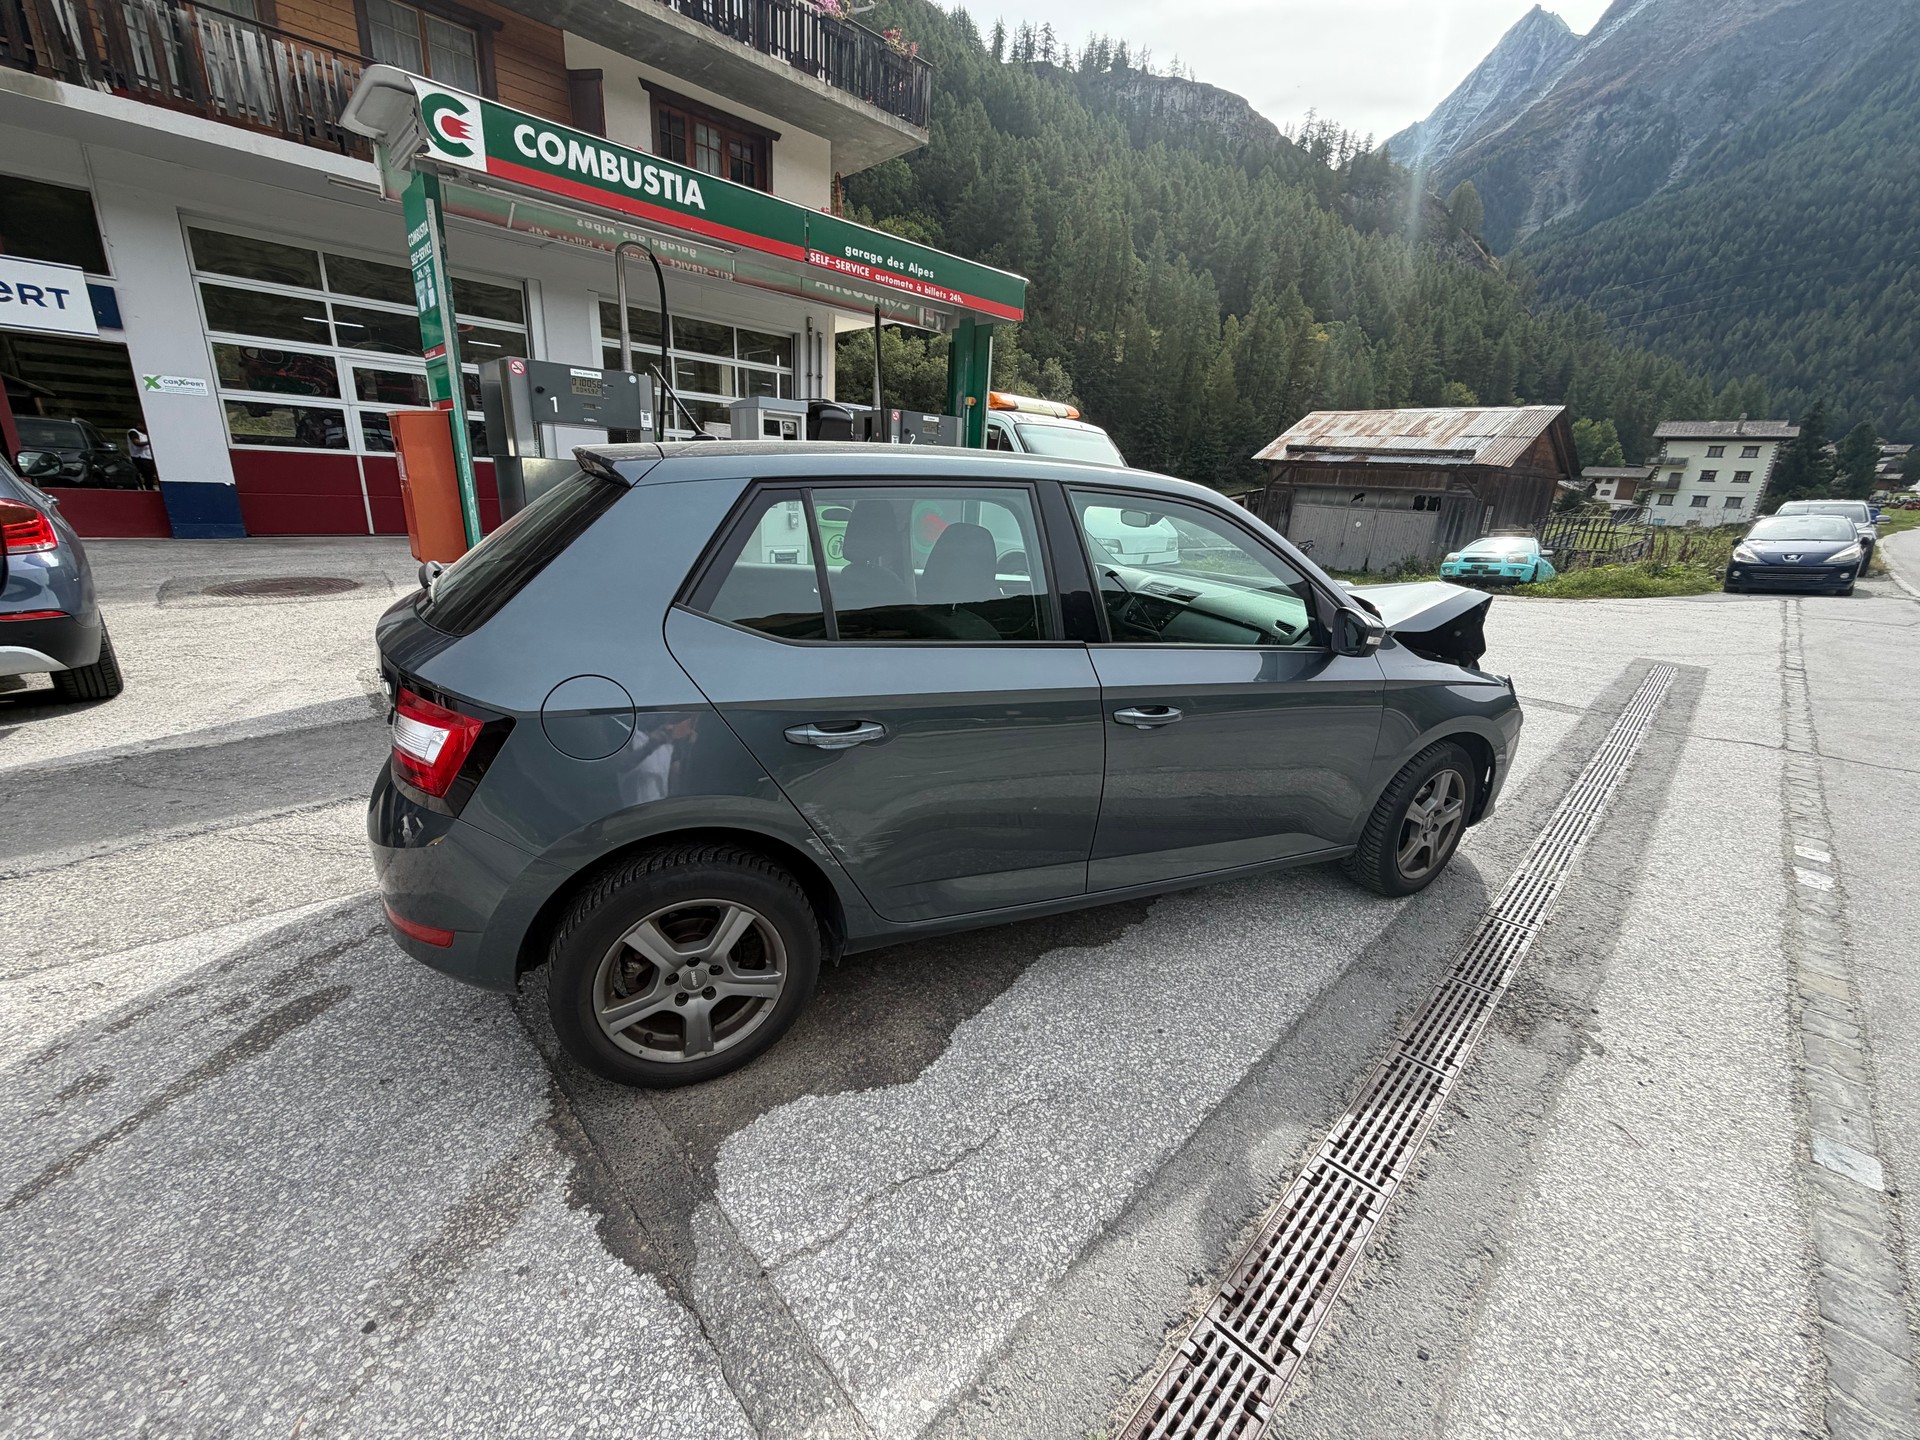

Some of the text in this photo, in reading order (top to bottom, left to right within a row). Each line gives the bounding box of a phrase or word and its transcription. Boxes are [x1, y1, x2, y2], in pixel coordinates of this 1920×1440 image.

[514, 124, 706, 210] COMBUSTIA
[810, 252, 870, 277] SELF-SERVICE
[875, 274, 914, 290] automate
[916, 283, 922, 292] à
[924, 285, 947, 300] billets
[845, 246, 934, 279] garage des Alpes
[550, 396, 558, 413] 1
[910, 434, 916, 445] 2
